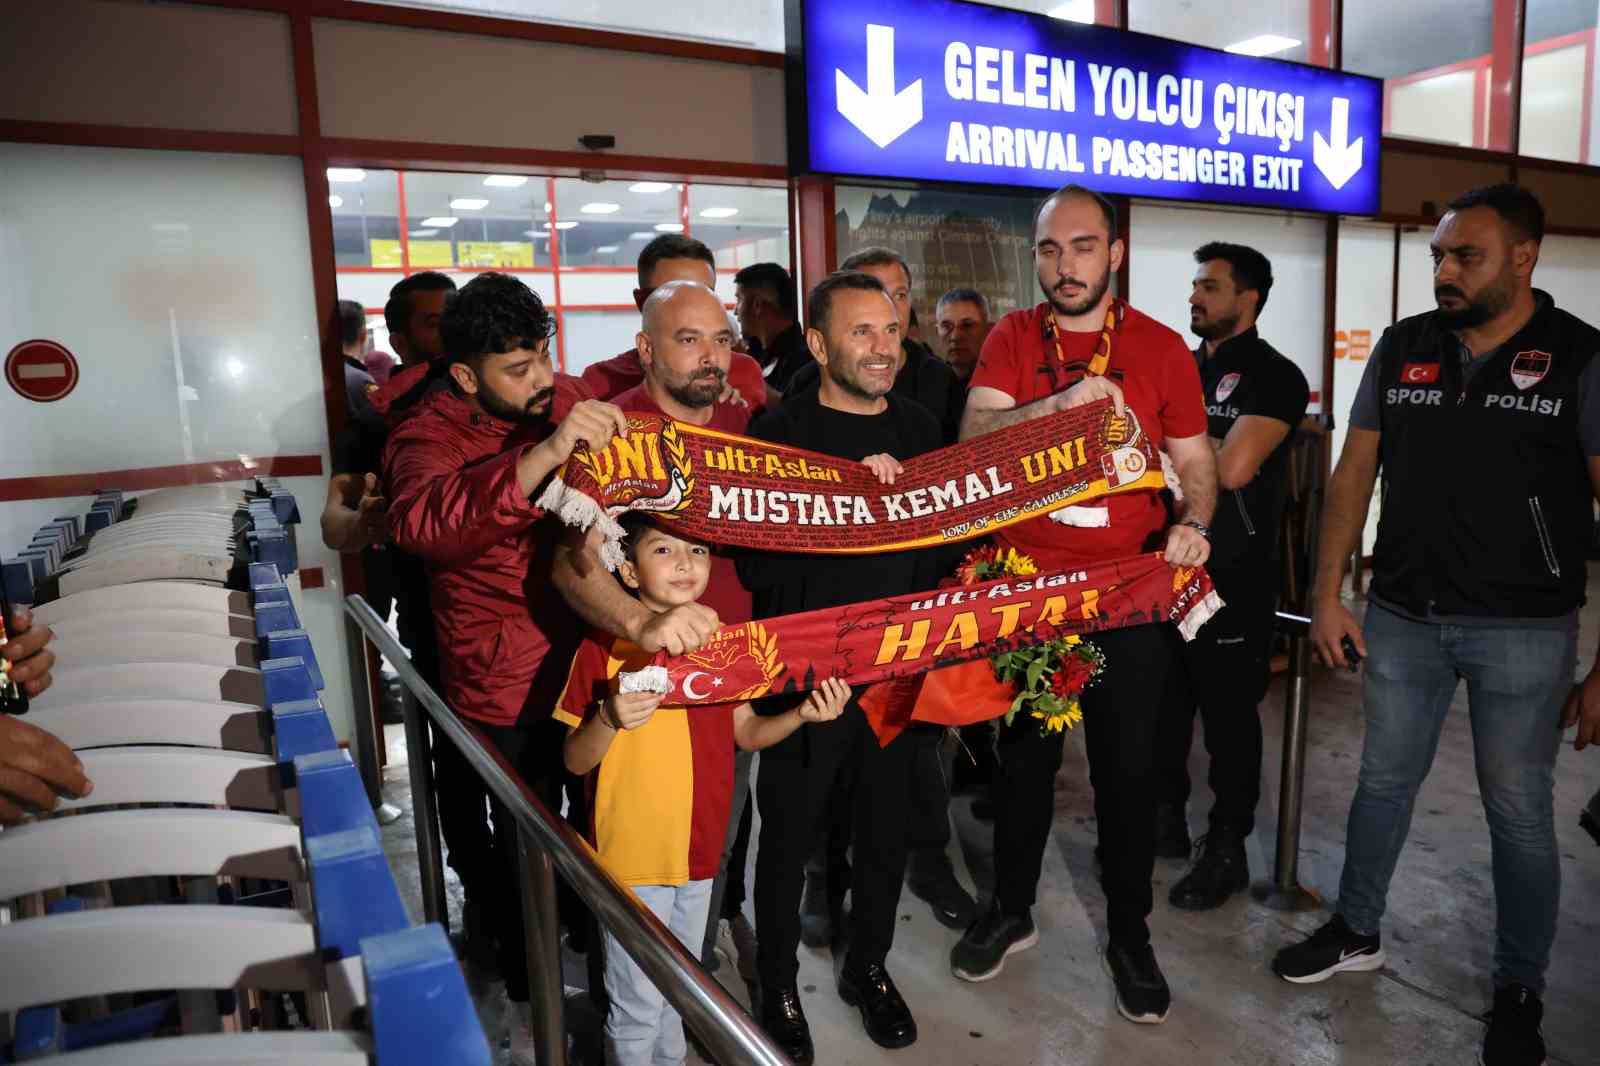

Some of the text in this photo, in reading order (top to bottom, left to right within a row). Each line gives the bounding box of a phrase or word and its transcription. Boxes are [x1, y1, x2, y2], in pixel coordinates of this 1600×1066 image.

[944, 41, 1305, 152] GELEN YOLCU ÇIKIŞI
[945, 121, 1303, 192] ARRIVAL PASSENGER EXIT
[1386, 388, 1563, 416] SPOR POLİSİ
[588, 432, 668, 487] UNI
[704, 446, 842, 483] ultrAslan
[707, 436, 1088, 525] MUSTAFA KEMAL UNI
[974, 515, 991, 530] OF
[995, 506, 1020, 523] THE
[910, 570, 1089, 611] ultrAslan
